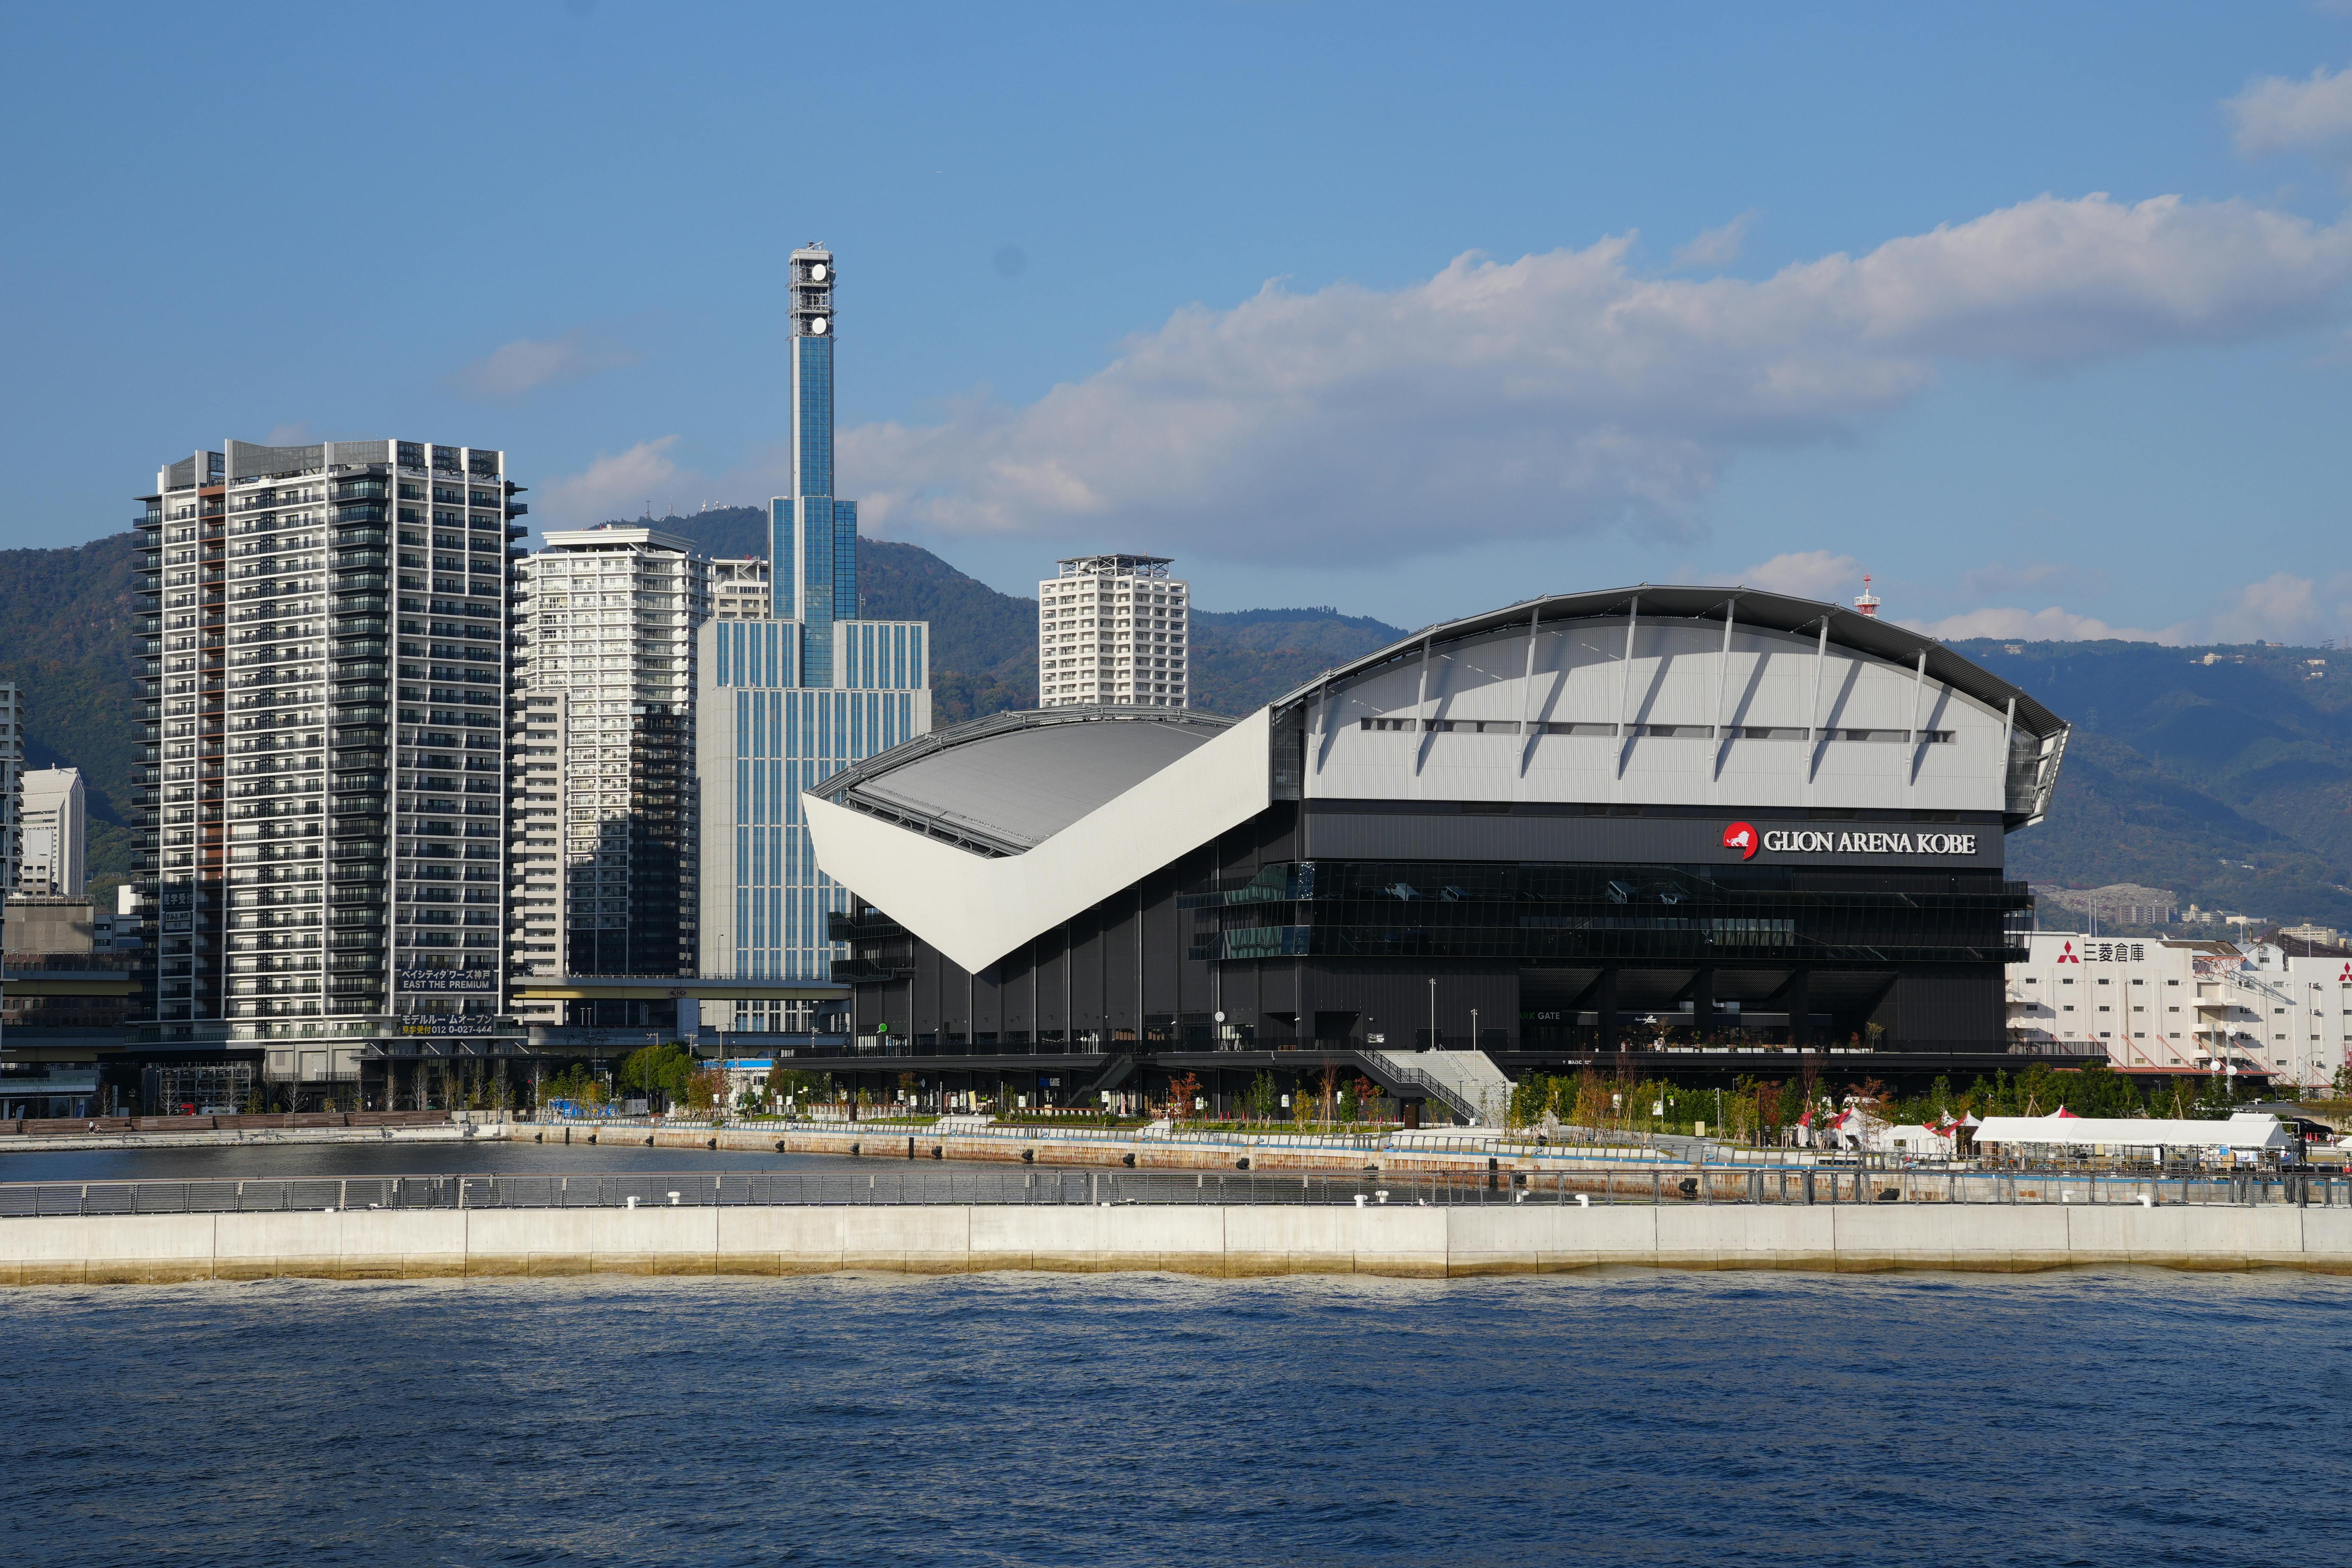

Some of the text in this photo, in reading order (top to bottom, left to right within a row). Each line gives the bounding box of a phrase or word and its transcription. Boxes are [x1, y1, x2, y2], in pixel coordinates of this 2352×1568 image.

[1764, 830, 1976, 854] GLION ARENA KOBE
[164, 893, 193, 905] 見学受付
[2084, 943, 2144, 962] 三菱倉庫
[402, 970, 490, 979] ベイシティタワーズ神戸
[402, 1014, 492, 1024] モデルルームオープン
[402, 1026, 431, 1034] 見学受付
[1050, 1078, 1060, 1086] GATE
